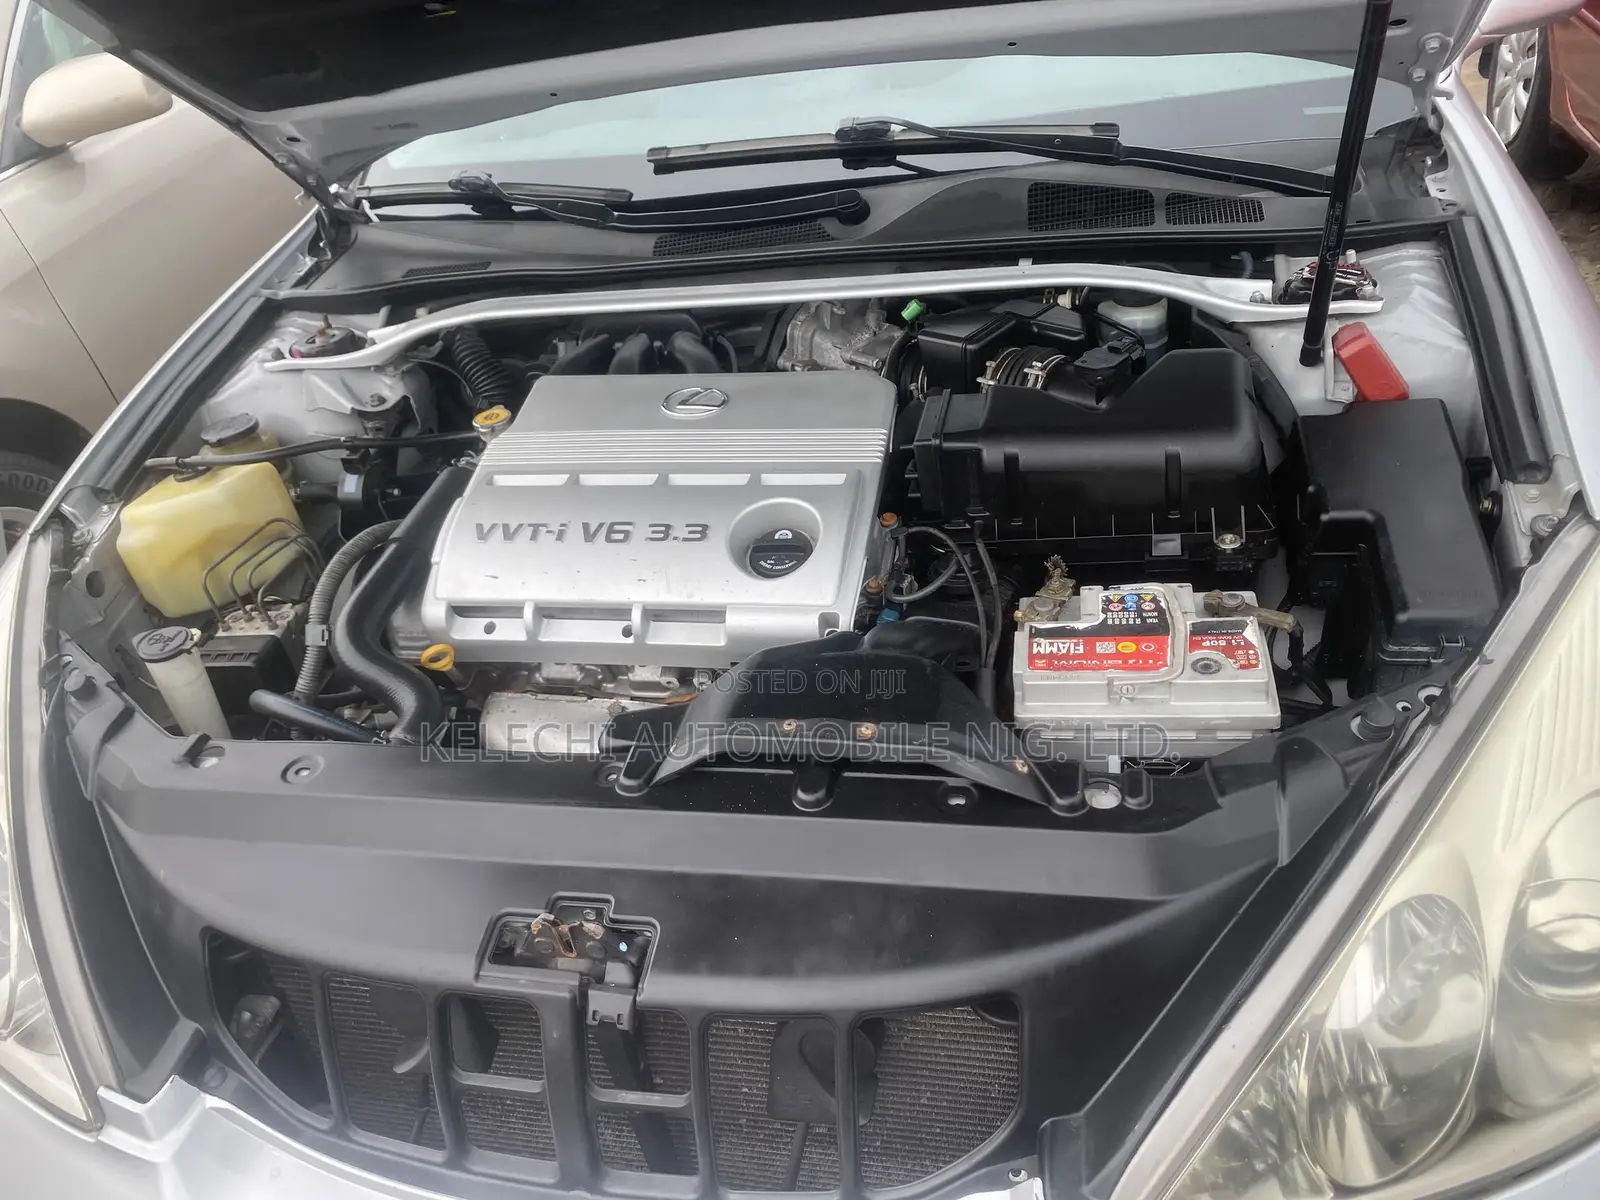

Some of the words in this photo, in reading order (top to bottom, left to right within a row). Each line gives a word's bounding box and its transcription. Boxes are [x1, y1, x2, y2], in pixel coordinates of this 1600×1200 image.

[475, 521, 571, 543] VVT-i
[581, 521, 635, 544] V6
[645, 523, 711, 543] 3.3
[1032, 641, 1084, 655] FIAMM
